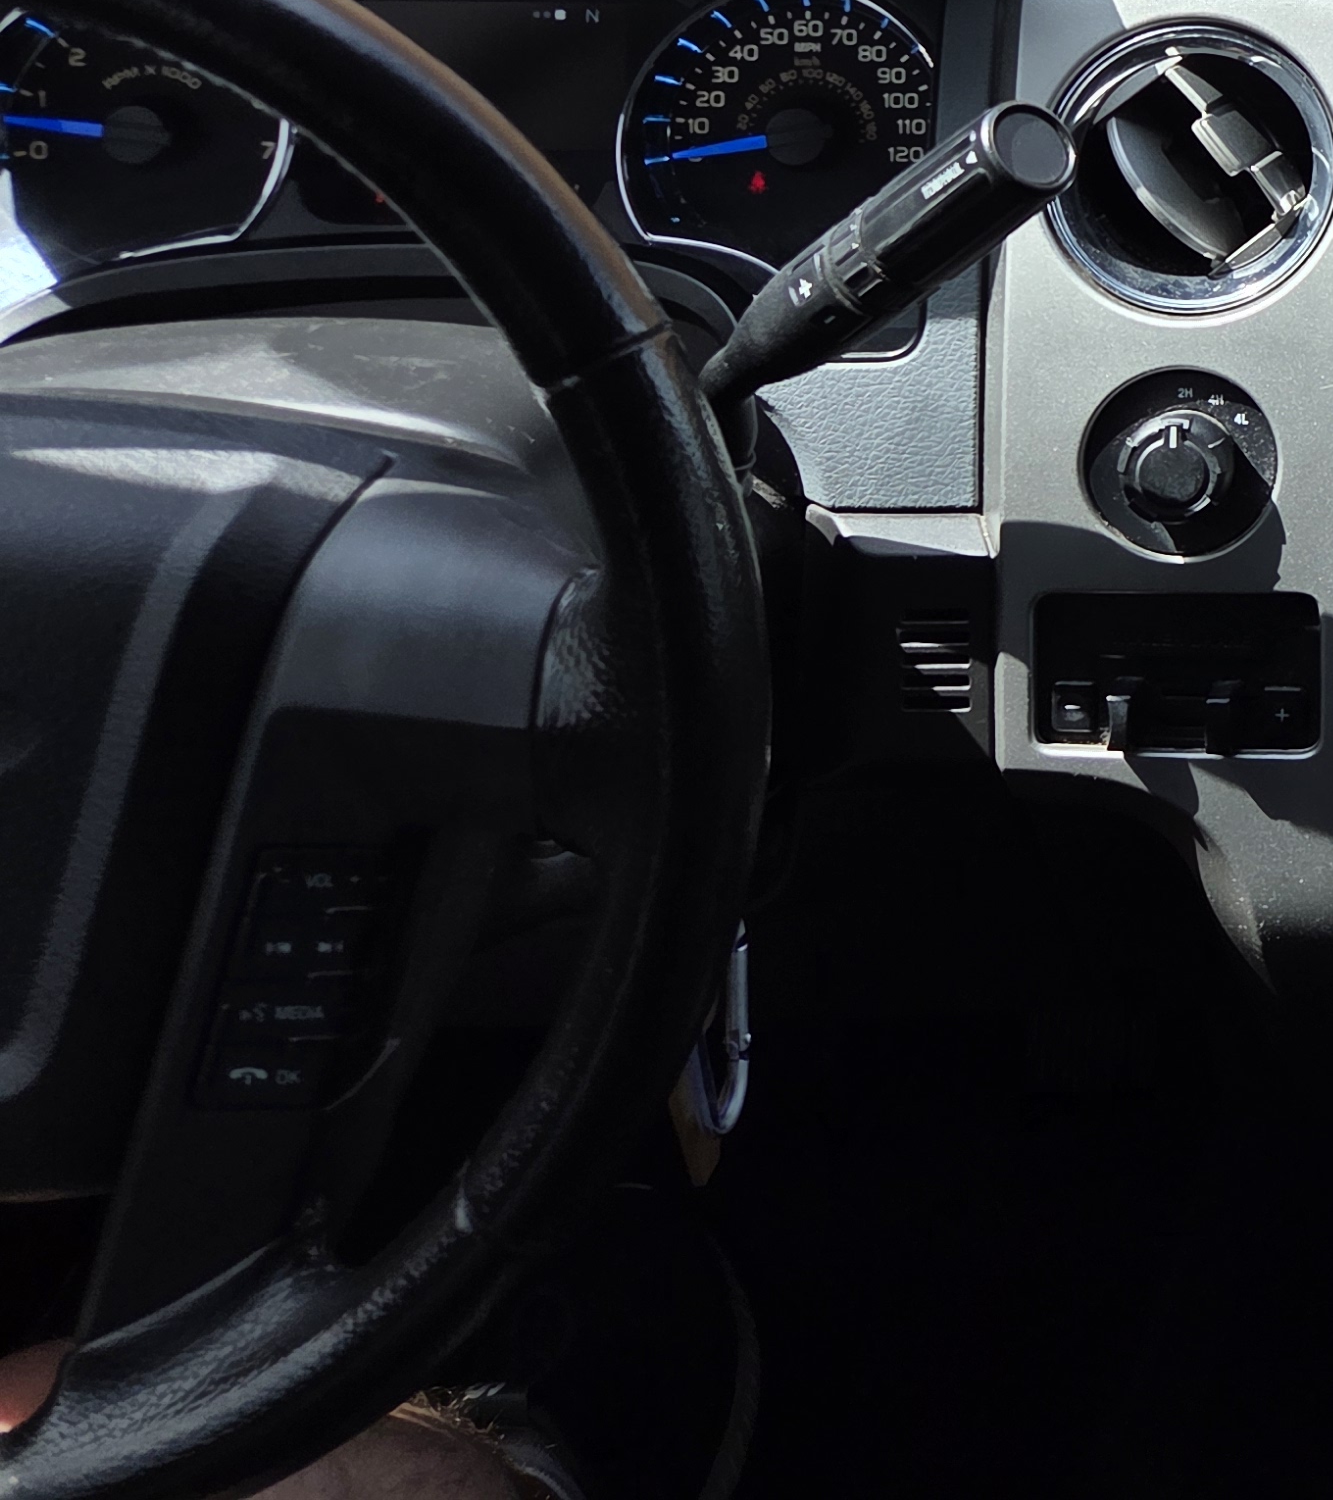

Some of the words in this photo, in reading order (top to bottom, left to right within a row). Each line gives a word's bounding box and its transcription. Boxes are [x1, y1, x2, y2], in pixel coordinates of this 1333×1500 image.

[760, 27, 789, 45] 50
[793, 20, 823, 37] 60
[831, 28, 858, 47] 70
[68, 47, 87, 67] 2
[729, 44, 759, 61] 40
[857, 45, 887, 62] 80
[161, 64, 203, 90] 1000
[711, 66, 739, 83] 30
[877, 67, 906, 84] 90
[38, 90, 47, 107] 1
[695, 90, 725, 107] 20
[882, 93, 919, 109] 100
[688, 117, 709, 134] 10
[897, 119, 926, 135] 110
[29, 140, 48, 160] 0
[260, 141, 277, 160] 7
[888, 146, 924, 163] 120
[1178, 387, 1193, 398] 2H
[1233, 413, 1249, 425] 4L
[276, 1069, 302, 1085] OK
